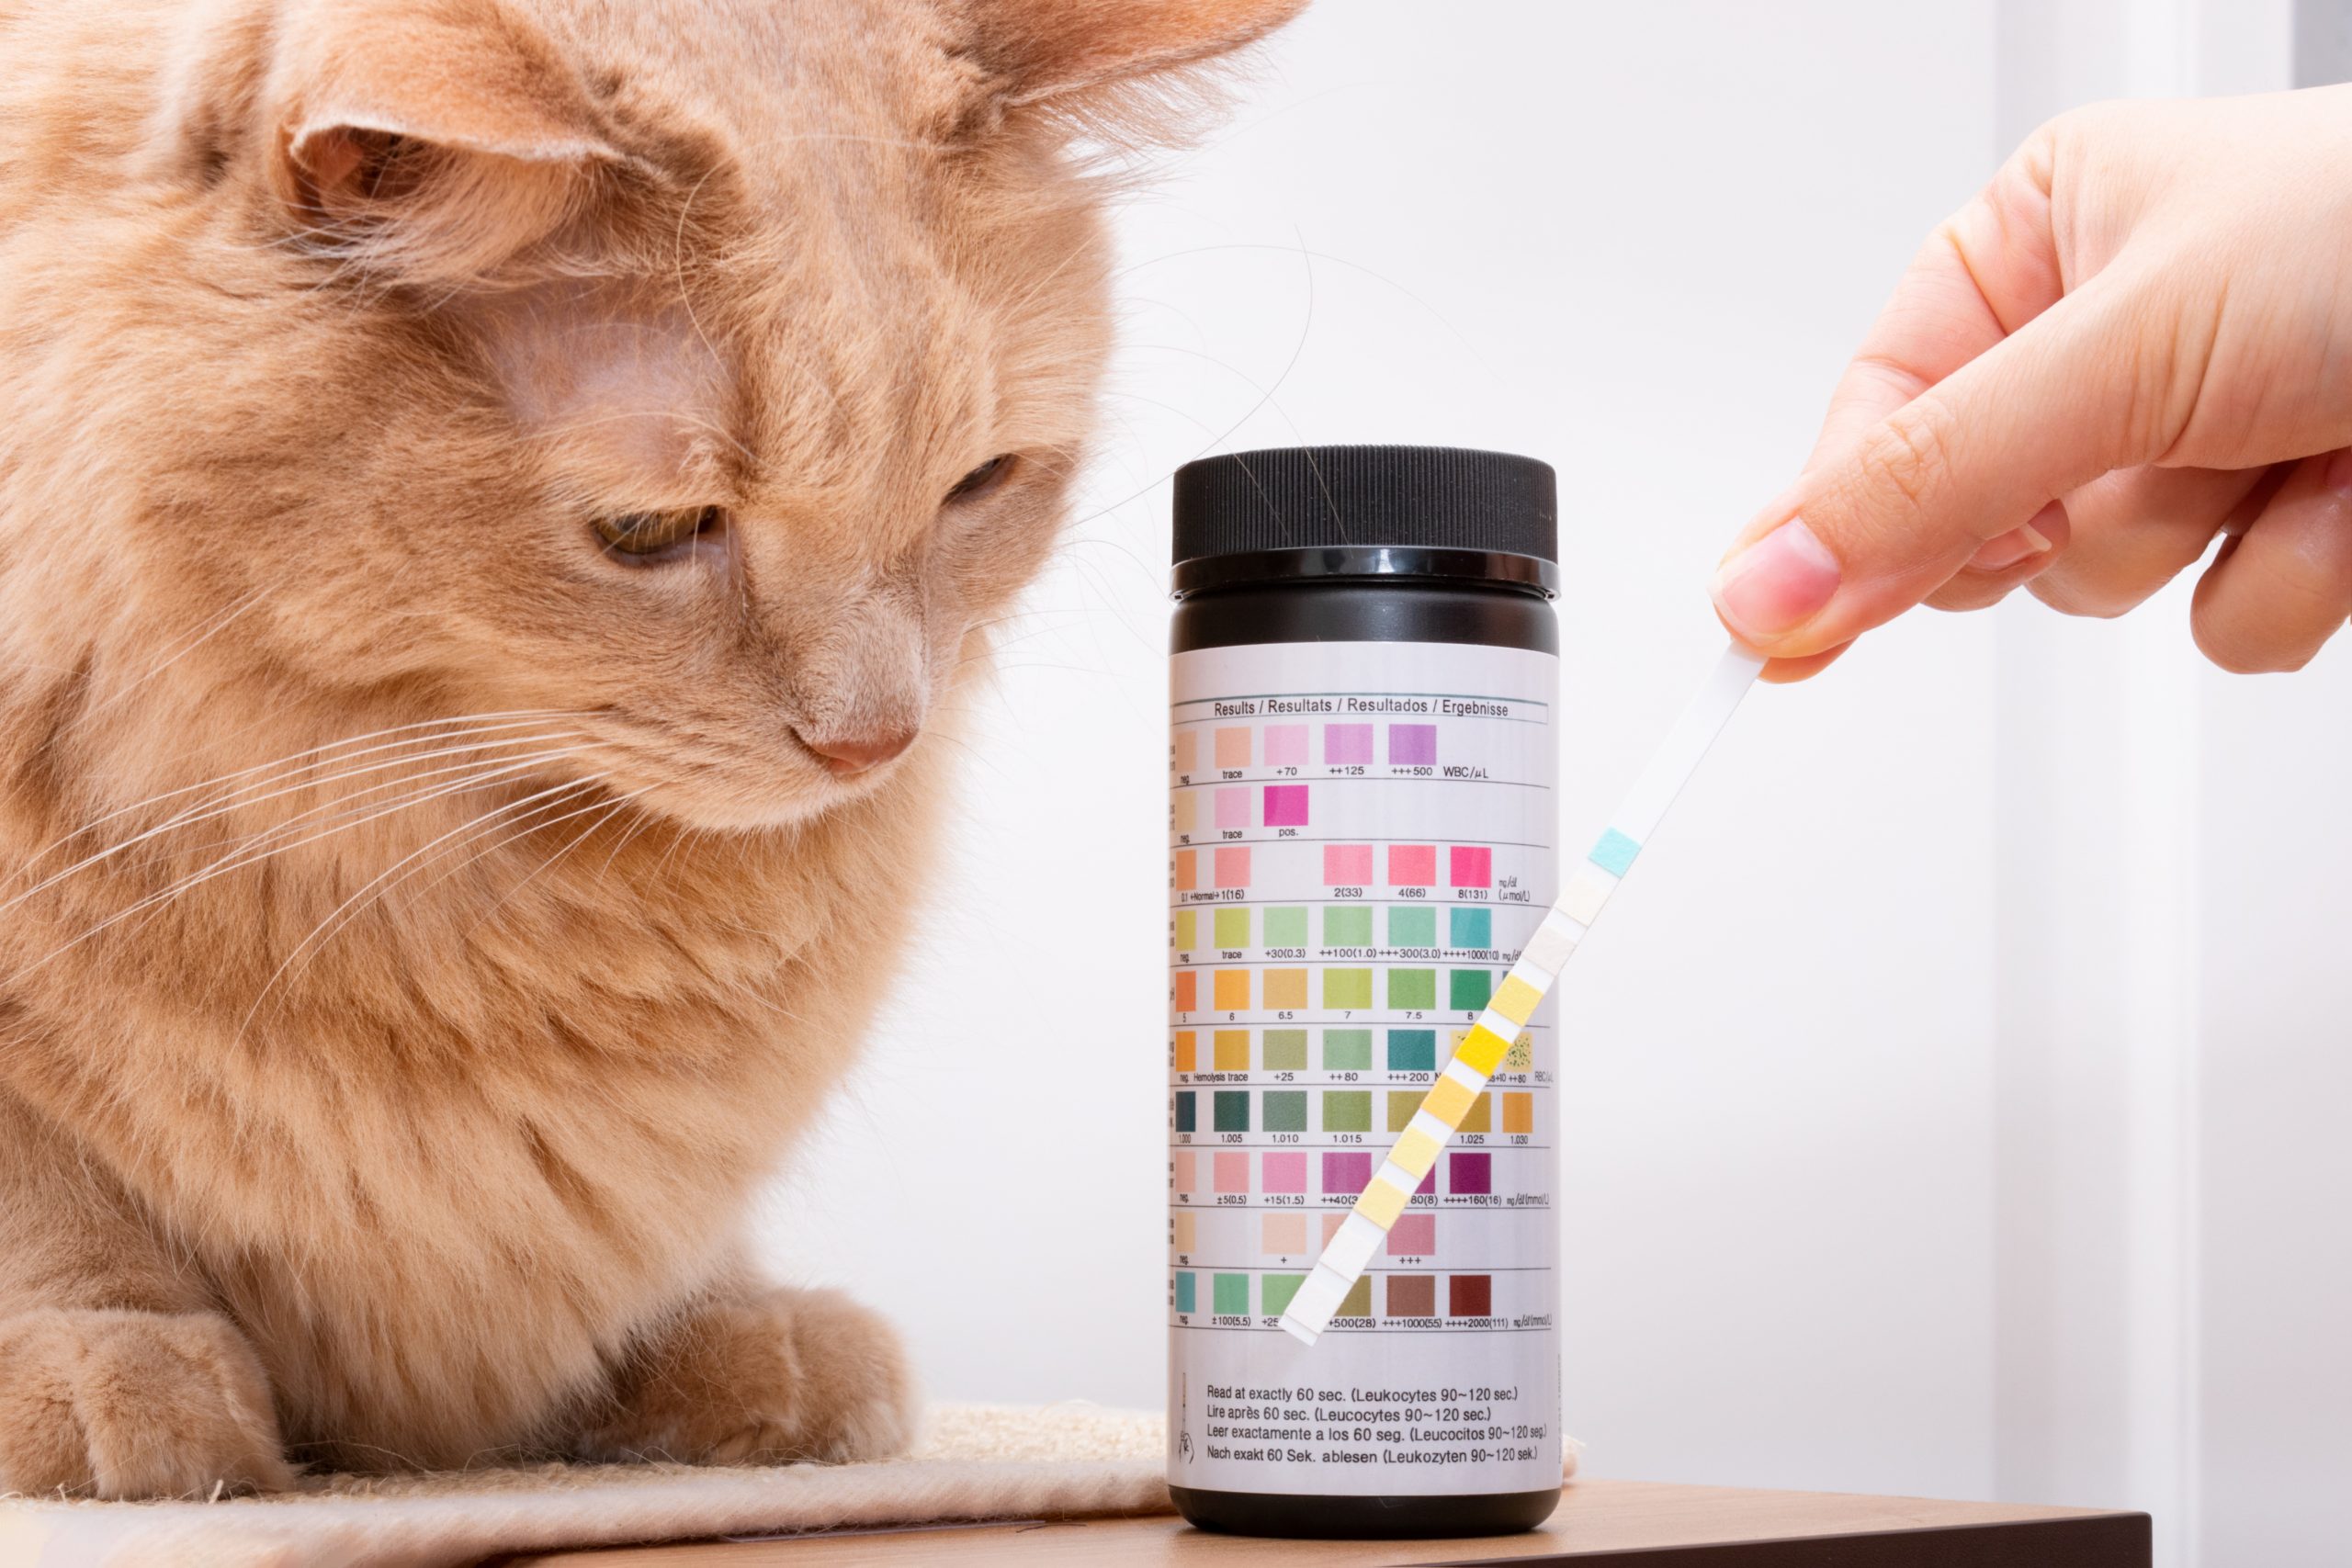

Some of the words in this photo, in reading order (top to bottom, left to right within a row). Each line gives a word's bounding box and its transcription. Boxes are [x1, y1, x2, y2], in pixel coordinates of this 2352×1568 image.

[1215, 702, 1255, 716] Results
[1269, 699, 1331, 713] Resultats
[1348, 698, 1427, 712] Resultados
[1443, 698, 1510, 716] Ergebnisse
[1223, 770, 1242, 780] trace
[1223, 830, 1242, 839] trace
[1279, 829, 1298, 837] pos.
[1222, 889, 1244, 900] 1(16)
[1334, 887, 1363, 897] 2(33)
[1398, 888, 1426, 897] 4(66)
[1458, 889, 1487, 899] 8(131)
[1222, 951, 1242, 959] trace
[1265, 949, 1306, 958] +30(0.3)
[1319, 949, 1376, 958] ++100(1.0)
[1379, 949, 1441, 958] +++300(3.0)
[1229, 1012, 1234, 1021] 6
[1279, 1011, 1293, 1020] 6.5
[1468, 1011, 1473, 1020] 8
[1193, 1073, 1226, 1084] Hemolysis
[1228, 1073, 1248, 1081] trace
[1274, 1073, 1294, 1081] +25
[1222, 1134, 1242, 1143] 1.005
[1272, 1134, 1298, 1143] 1.010
[1334, 1134, 1362, 1143] 1.015
[1461, 1134, 1484, 1144] 1.025
[1510, 1135, 1528, 1145] 1.030
[1264, 1196, 1304, 1204] +15(1.5)
[1444, 1196, 1501, 1206] ++++160(16)
[1382, 1318, 1442, 1328] +++1000(55)
[1207, 1386, 1231, 1399] Read
[1235, 1387, 1245, 1399] at
[1250, 1388, 1293, 1403] exactly
[1297, 1388, 1314, 1401] 60
[1318, 1391, 1345, 1401] sec.
[1351, 1388, 1436, 1404] (Leukocytes
[1442, 1388, 1490, 1402] 90~120
[1494, 1386, 1518, 1401] sec.)
[1207, 1404, 1225, 1417] Lire
[1228, 1406, 1260, 1420] après
[1263, 1407, 1279, 1420] 60
[1283, 1410, 1309, 1420] sec.
[1315, 1407, 1400, 1423] (Leucocytes
[1405, 1408, 1459, 1422] 90~120
[1464, 1406, 1491, 1421] sec.)
[1207, 1424, 1228, 1437] Leer
[1232, 1427, 1311, 1440] exactamente
[1316, 1430, 1324, 1440] a
[1329, 1428, 1349, 1440] los
[1354, 1427, 1372, 1441] 60
[1376, 1431, 1404, 1443] seg.
[1410, 1427, 1485, 1441] (Leucocitos
[1488, 1426, 1528, 1439] 90~120
[1531, 1425, 1546, 1439] seg.)
[1208, 1445, 1230, 1459] Nach
[1234, 1449, 1263, 1461] exakt
[1267, 1449, 1283, 1461] 60
[1287, 1450, 1316, 1462] Sek.
[1323, 1450, 1377, 1462] ablesen
[1384, 1450, 1466, 1464] (Leukozyten
[1471, 1448, 1515, 1462] 90~120
[1518, 1446, 1537, 1461] sek.)
